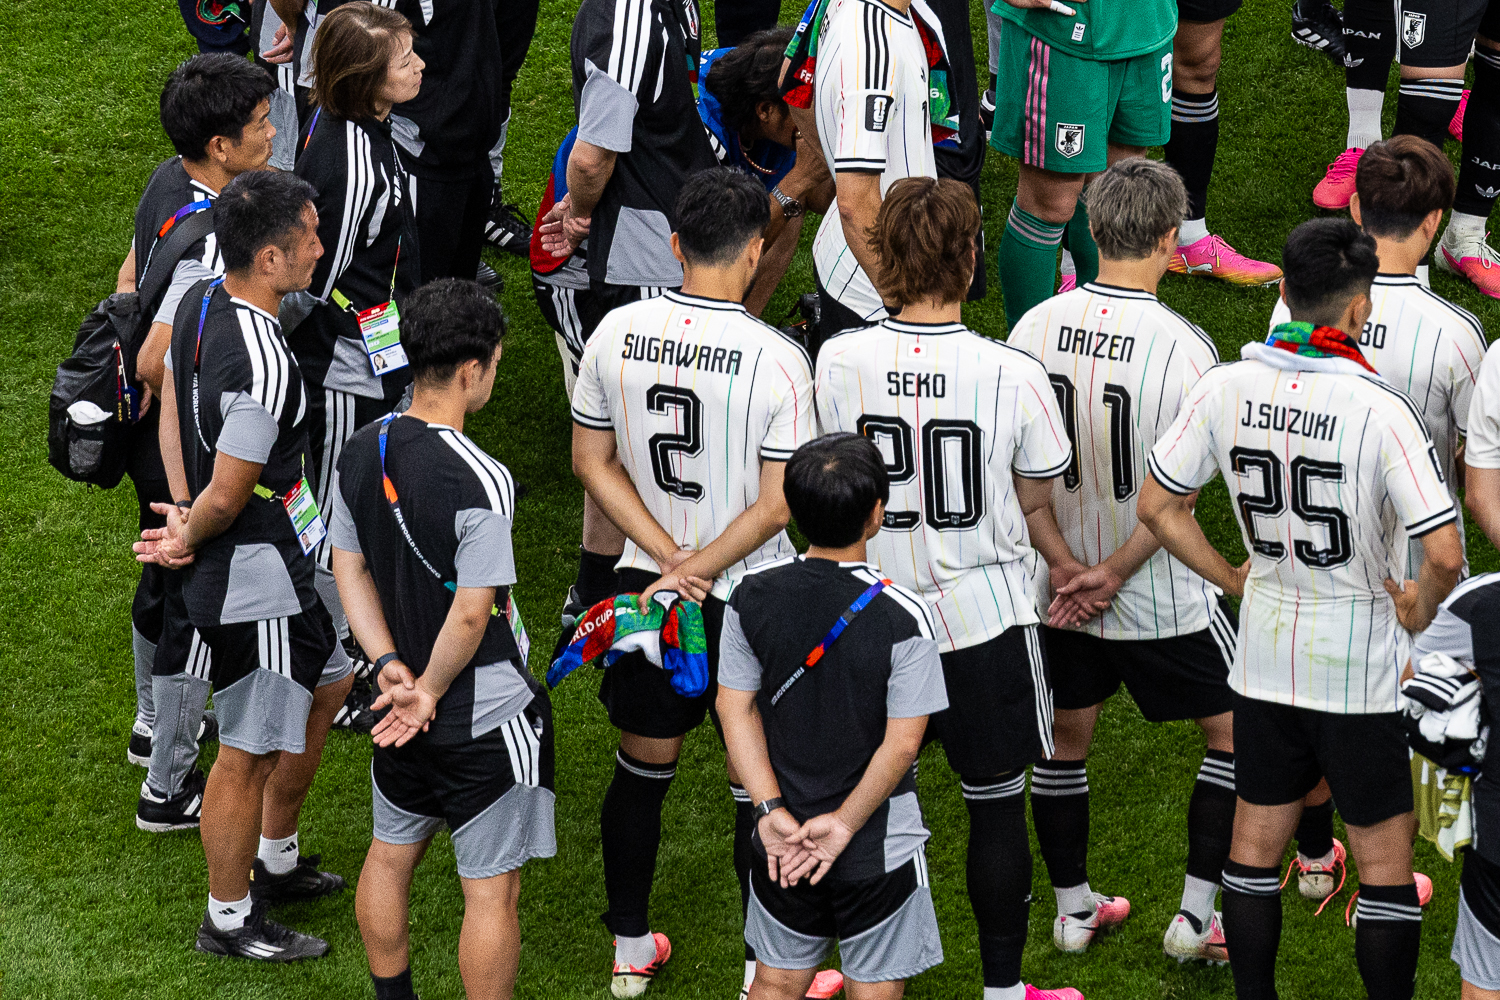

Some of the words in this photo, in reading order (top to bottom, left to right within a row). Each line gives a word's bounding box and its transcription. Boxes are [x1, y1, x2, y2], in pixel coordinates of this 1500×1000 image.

[621, 333, 743, 376] SUGAWARA
[1057, 326, 1135, 363] DAIZEN
[1359, 327, 1387, 354] BO
[886, 372, 946, 398] SEKO
[1241, 400, 1337, 441] J.SUZUKI
[646, 384, 705, 502] 2
[856, 413, 987, 533] 20
[1229, 445, 1355, 571] 25
[393, 506, 404, 524] FIFA
[400, 522, 415, 547] WORLD
[412, 545, 424, 561] CUP
[422, 558, 442, 579] 2026
[596, 608, 613, 629] CUP
